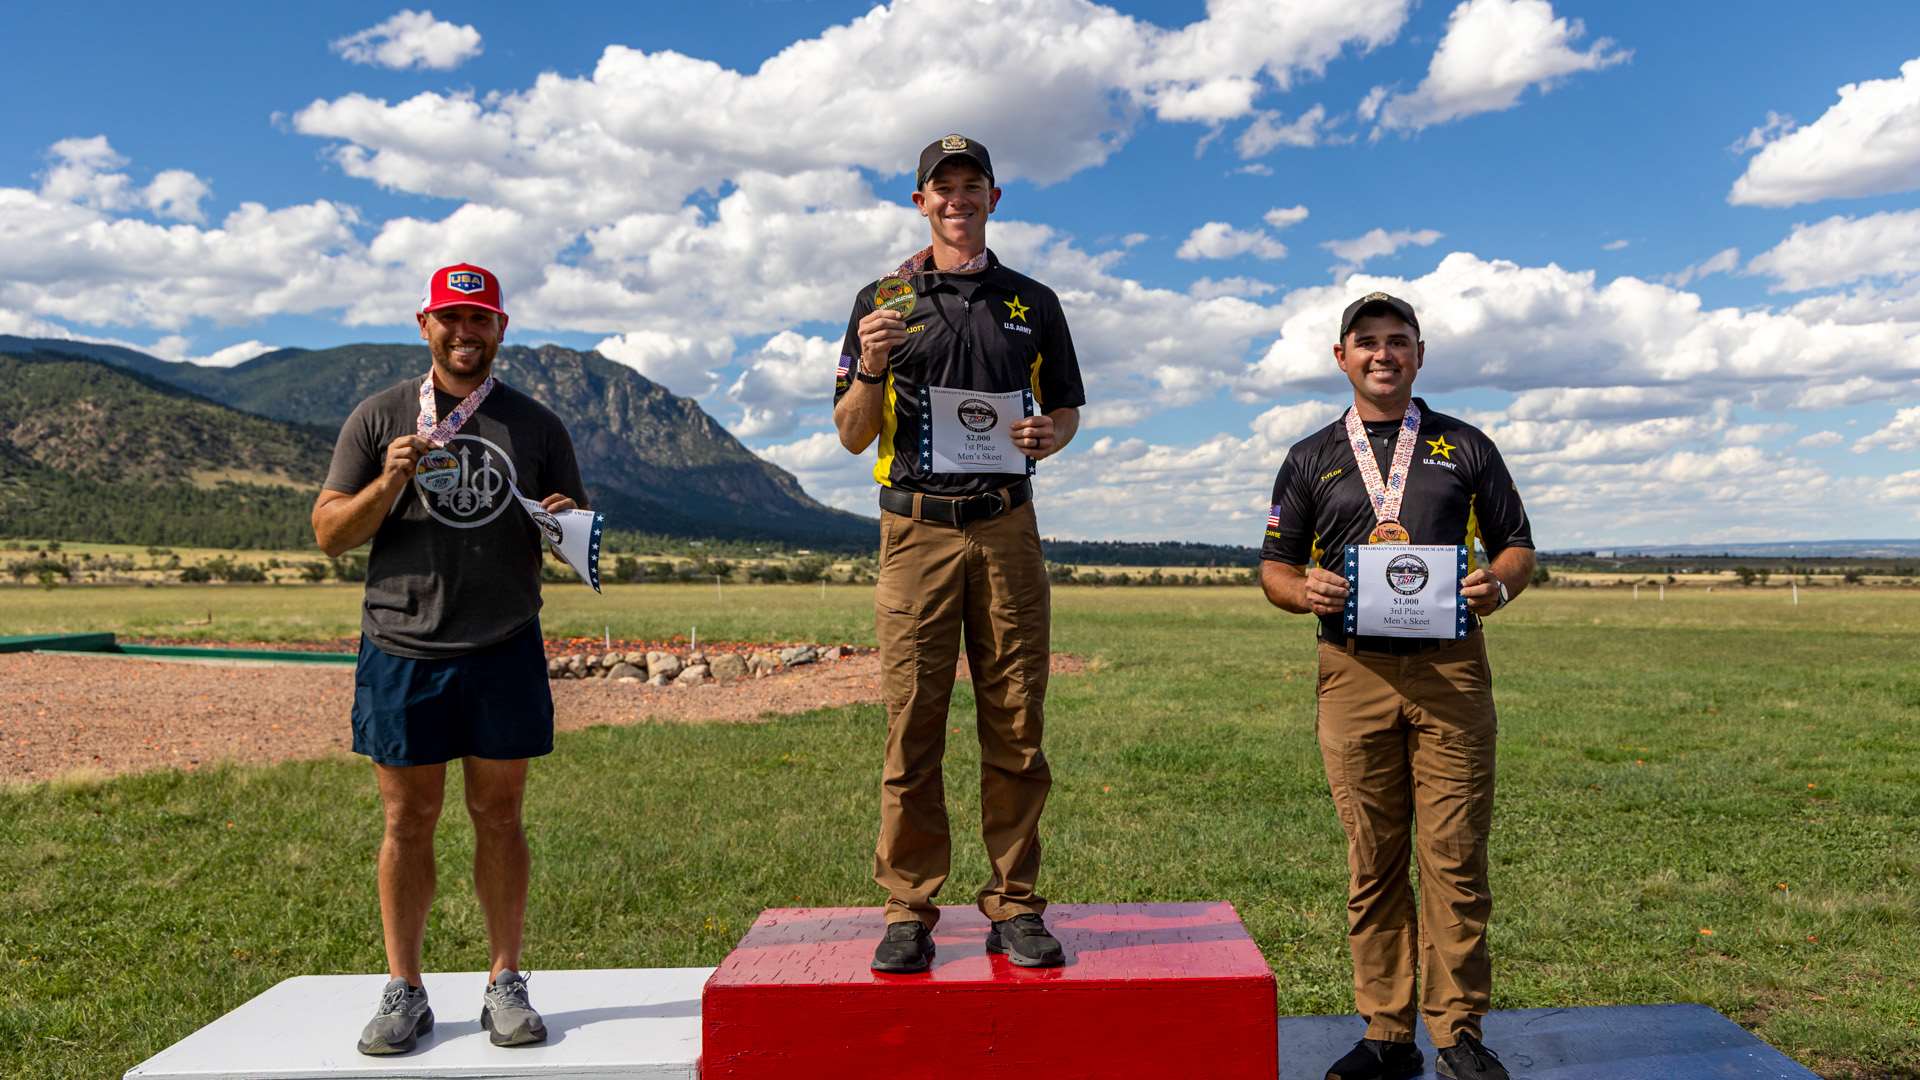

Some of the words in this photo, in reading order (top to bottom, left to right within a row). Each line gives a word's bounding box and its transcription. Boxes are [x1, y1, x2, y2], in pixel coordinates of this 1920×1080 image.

[451, 275, 481, 284] USA
[1016, 325, 1032, 335] ARMY
[965, 434, 991, 442] $2,000
[964, 443, 974, 451] 1st
[982, 453, 1002, 461] Skeet
[1436, 460, 1457, 470] ARMY
[1393, 597, 1419, 605] $1,000
[1389, 607, 1402, 615] 3rd
[1404, 607, 1425, 616] Place
[1383, 616, 1408, 624] Men's
[1409, 617, 1430, 625] Skeet
